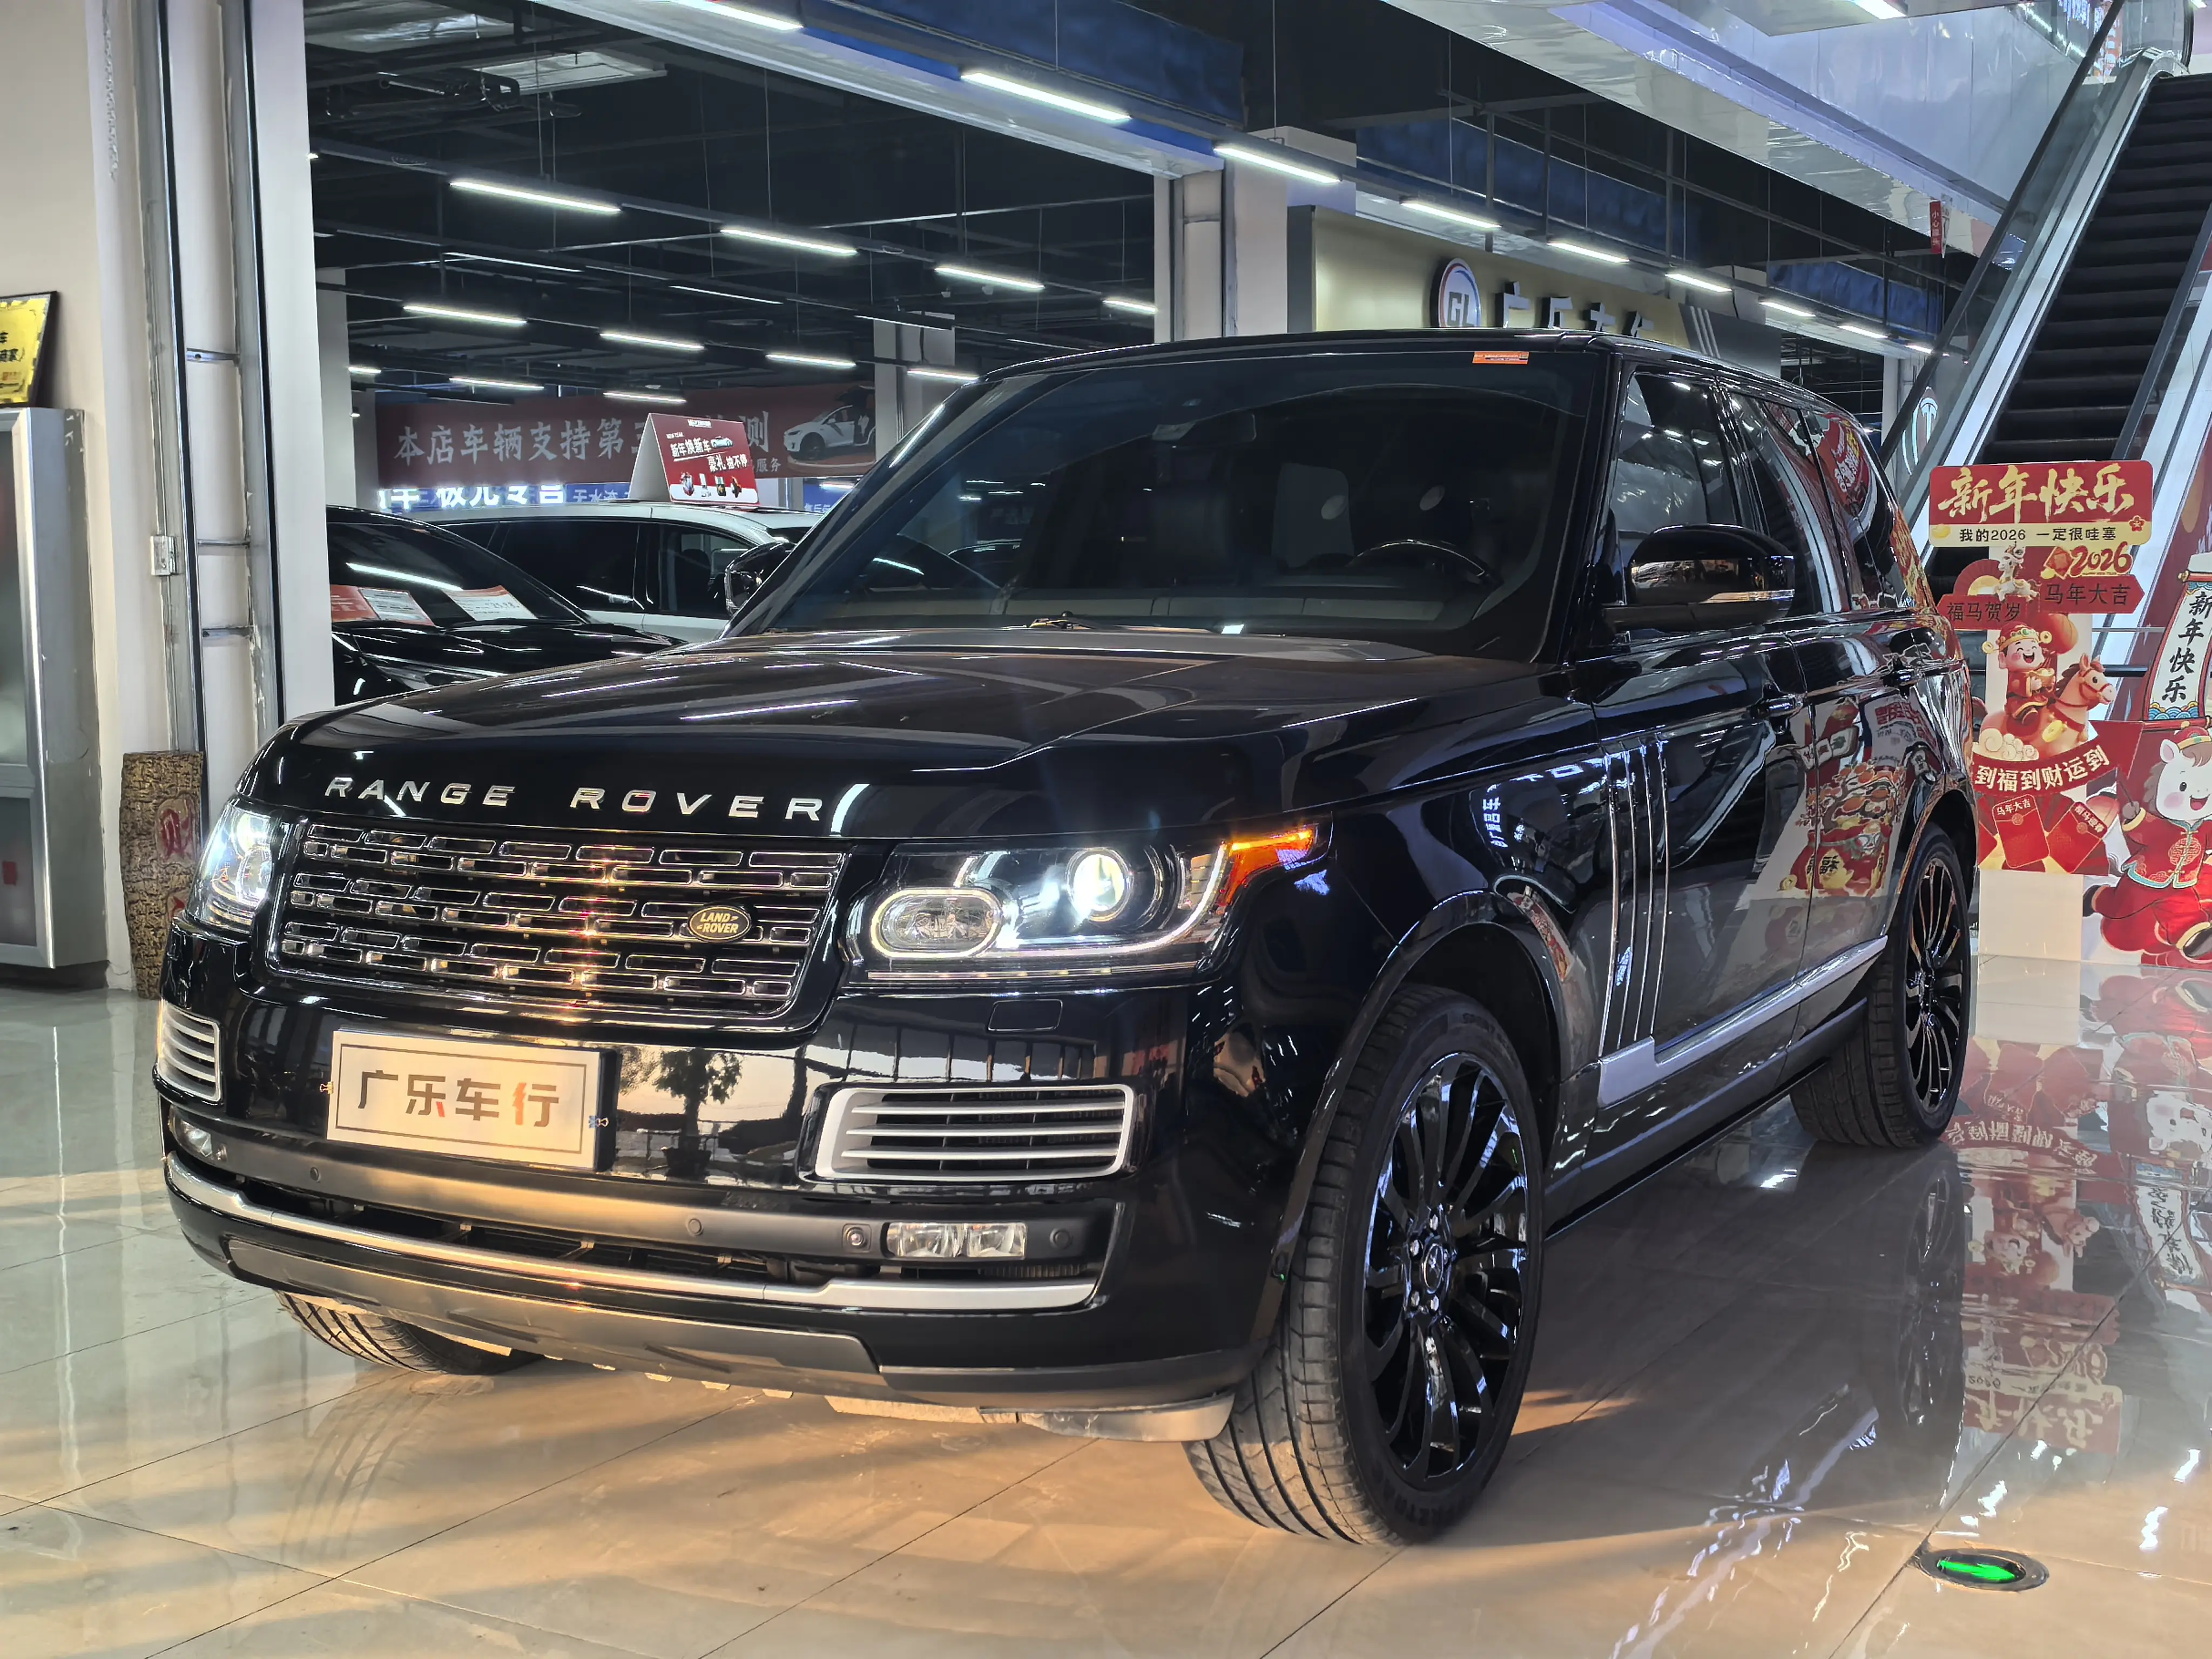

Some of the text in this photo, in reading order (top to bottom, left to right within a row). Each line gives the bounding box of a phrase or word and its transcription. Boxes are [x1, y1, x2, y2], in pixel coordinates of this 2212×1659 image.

[1938, 463, 2134, 523] 新年快乐
[1959, 527, 2116, 542] 我的2026 一定很哇塞
[2070, 541, 2133, 576] 2026
[2045, 583, 2131, 605] 马年大吉
[1946, 602, 2020, 622] 福马贺岁
[2161, 591, 2212, 703] 新年快乐
[1972, 745, 2110, 792] 到福到财运到
[325, 777, 822, 821] RANGE ROVER
[700, 913, 731, 922] LAND
[702, 923, 739, 934] ROVER
[358, 1069, 559, 1127] 广乐车行
